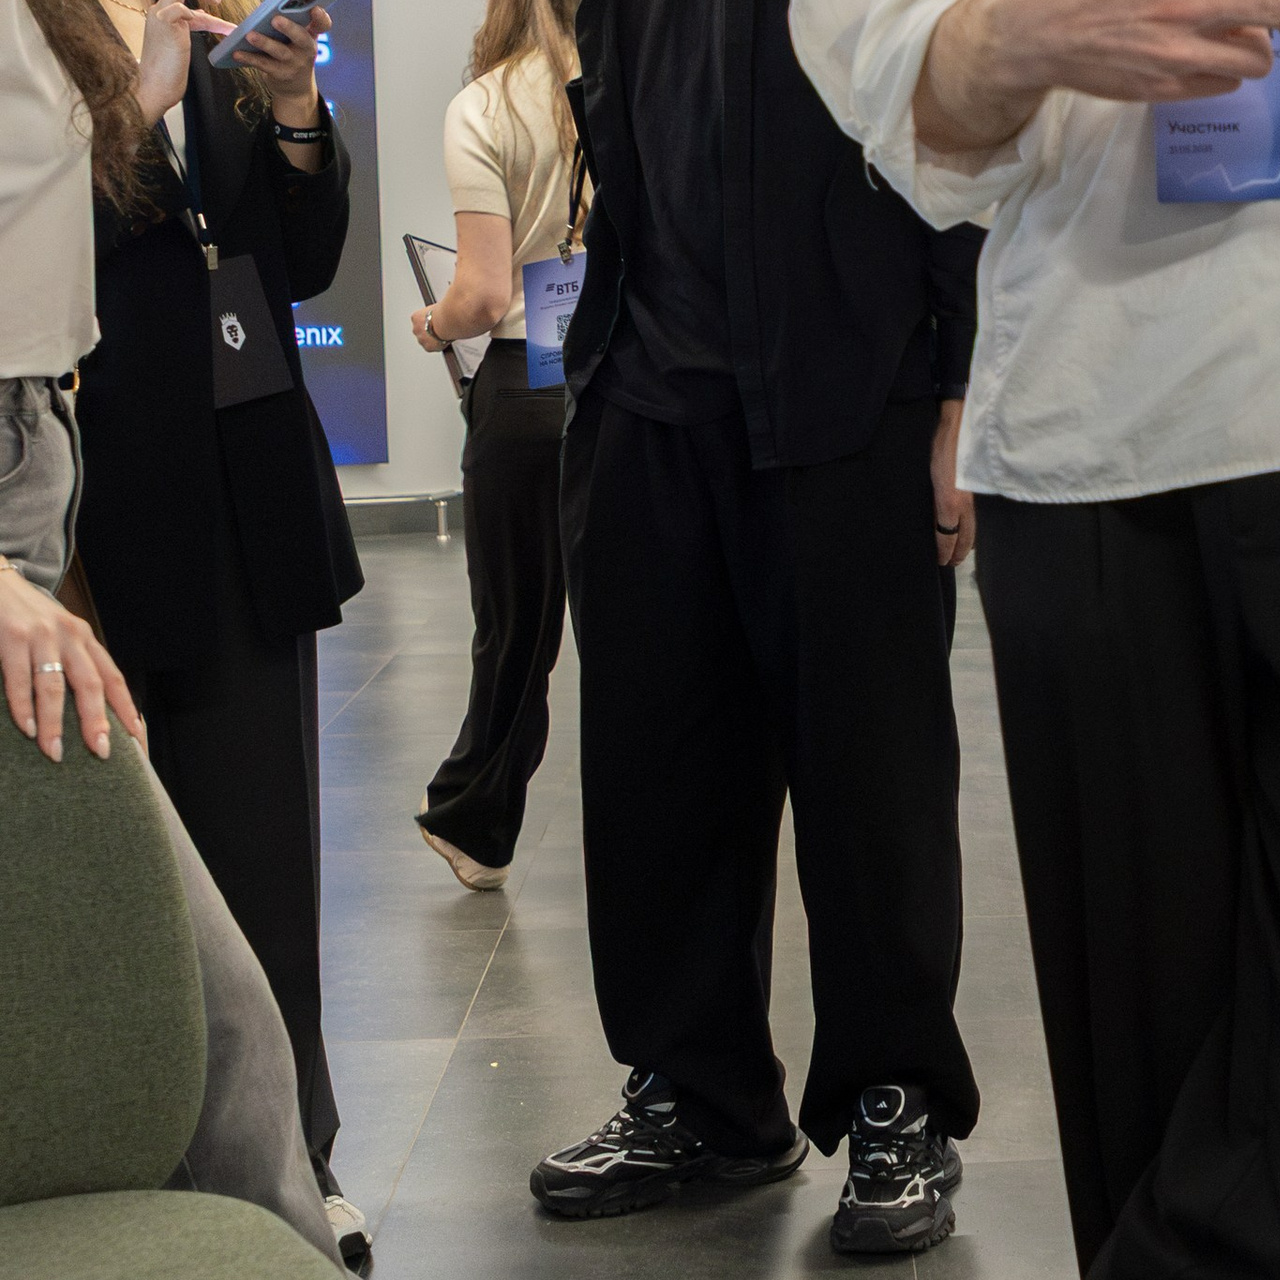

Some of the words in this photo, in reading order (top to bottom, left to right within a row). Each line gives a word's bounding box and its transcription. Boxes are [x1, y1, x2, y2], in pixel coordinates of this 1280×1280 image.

[1167, 121, 1240, 134] Участник
[556, 280, 579, 295] ВТБ
[295, 326, 344, 346] enix
